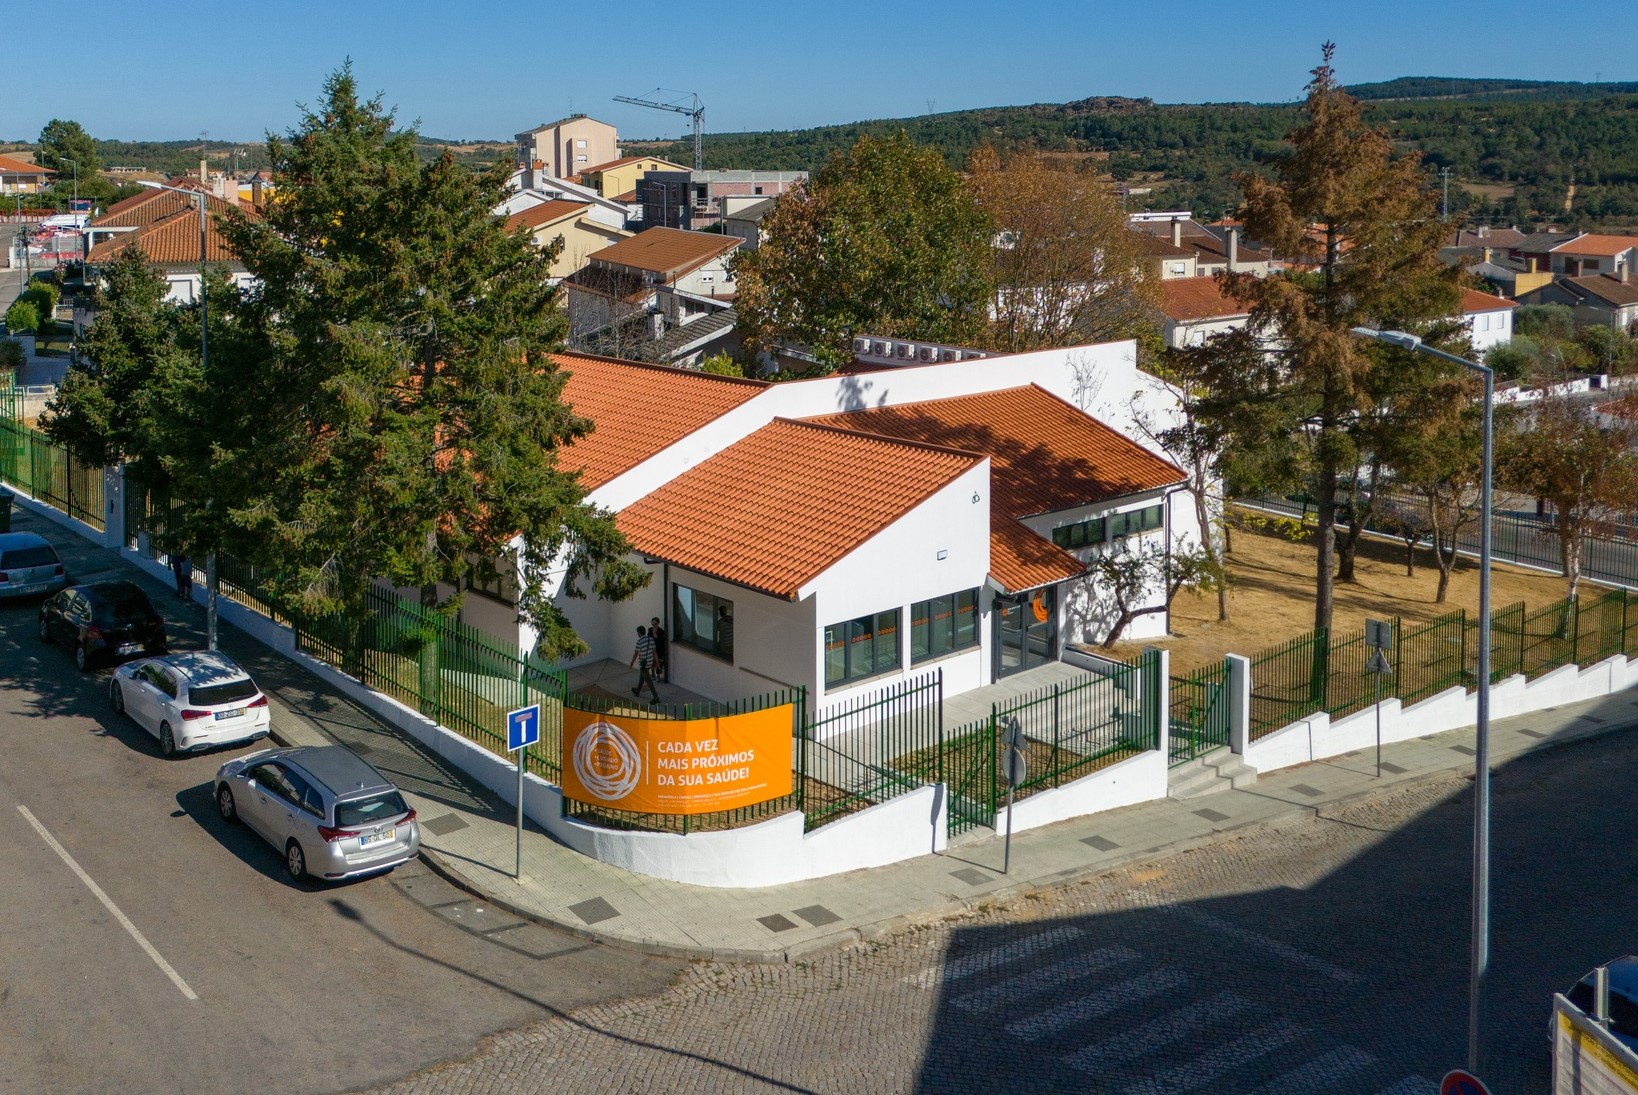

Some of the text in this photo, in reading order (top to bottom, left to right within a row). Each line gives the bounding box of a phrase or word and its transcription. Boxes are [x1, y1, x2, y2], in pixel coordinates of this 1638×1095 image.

[658, 739, 718, 754] CADA VEZ
[658, 749, 755, 770] MAIS PRÓXIMOS
[658, 767, 750, 786] DA SUA SAÚDE!
